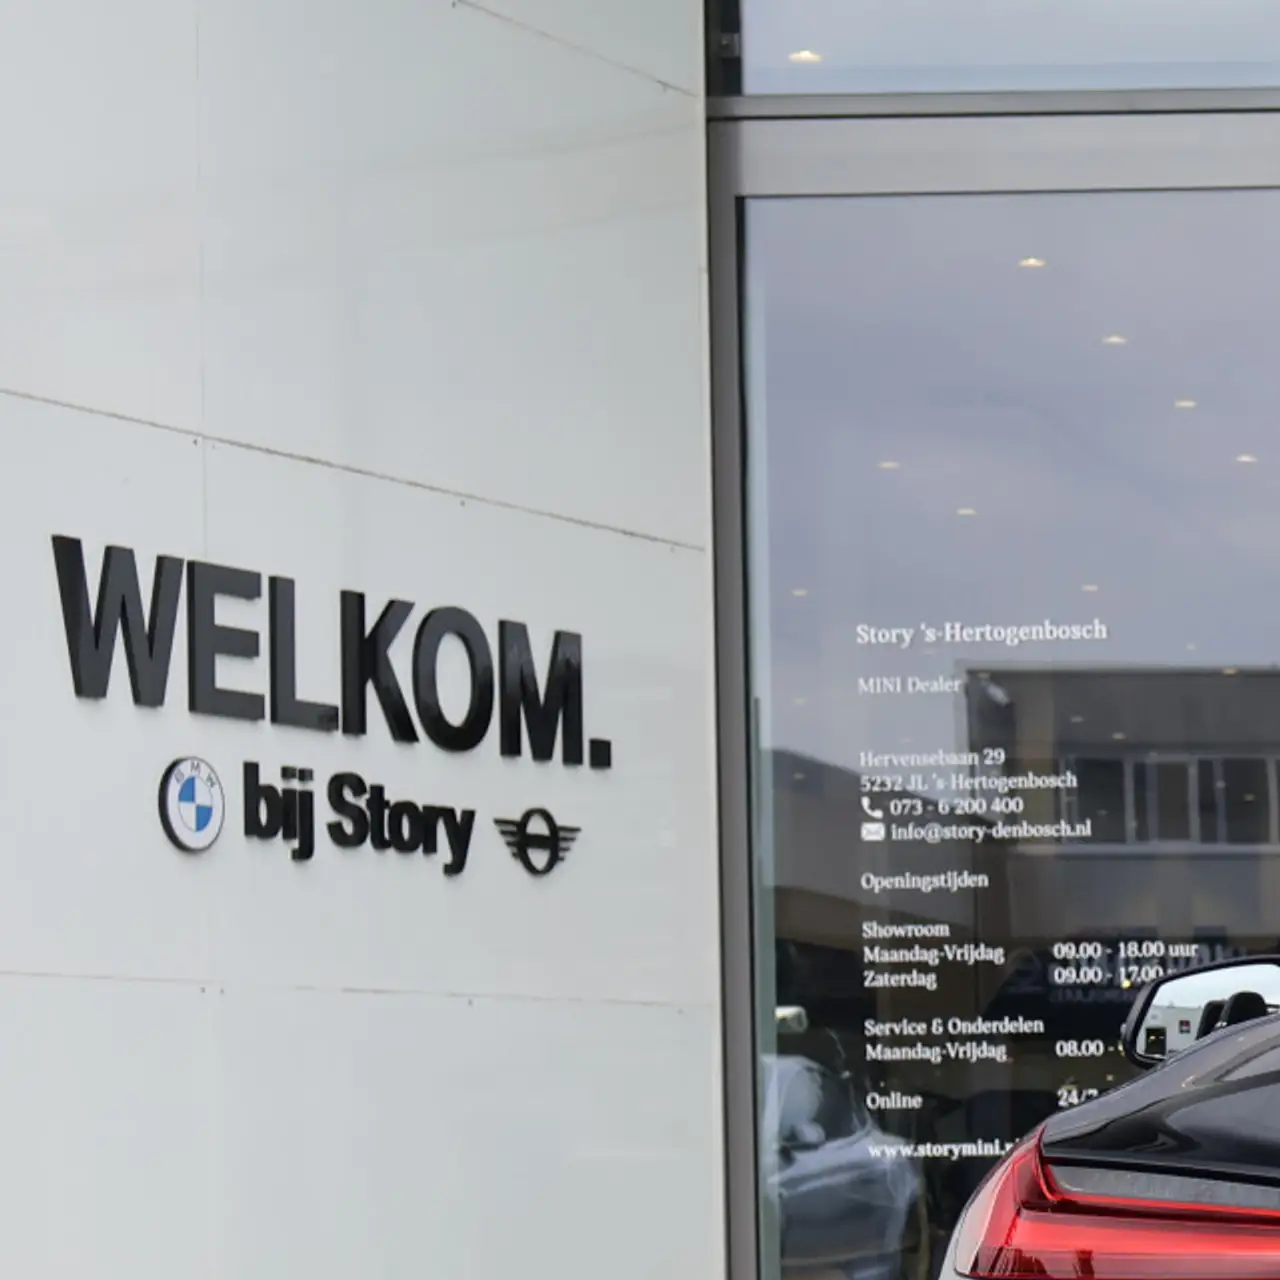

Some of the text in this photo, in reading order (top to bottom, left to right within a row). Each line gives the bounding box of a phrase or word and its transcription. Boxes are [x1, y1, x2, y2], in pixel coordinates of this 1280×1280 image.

[856, 619, 1107, 648] Story 's-Hertogenbosch
[52, 535, 612, 769] WELKOM.
[857, 676, 962, 693] MINI Dealer
[860, 747, 1006, 767] Hervensebaan 29
[860, 775, 902, 792] 5232
[905, 775, 928, 791] JL
[890, 799, 923, 815] 073
[938, 799, 950, 815] 6
[955, 798, 986, 815] 200
[991, 797, 1024, 813] 400
[243, 761, 476, 876] bij Story
[891, 819, 1092, 843] info@story-denbosch.nl
[861, 871, 989, 893] Openingstijden
[862, 920, 950, 939] Showroom
[863, 943, 1005, 965] Maandag-Vrijdag
[1053, 942, 1102, 960] 09.00
[1118, 940, 1165, 958] 18.00
[1168, 944, 1199, 957] uur
[863, 970, 938, 991] Zaterdag
[1053, 967, 1103, 984] 09.00
[864, 1015, 1045, 1037] Service & Onderdelen
[866, 1042, 1008, 1064] Maandag-Vrijdag
[1055, 1040, 1104, 1057] 08.00
[866, 1091, 923, 1110] Online
